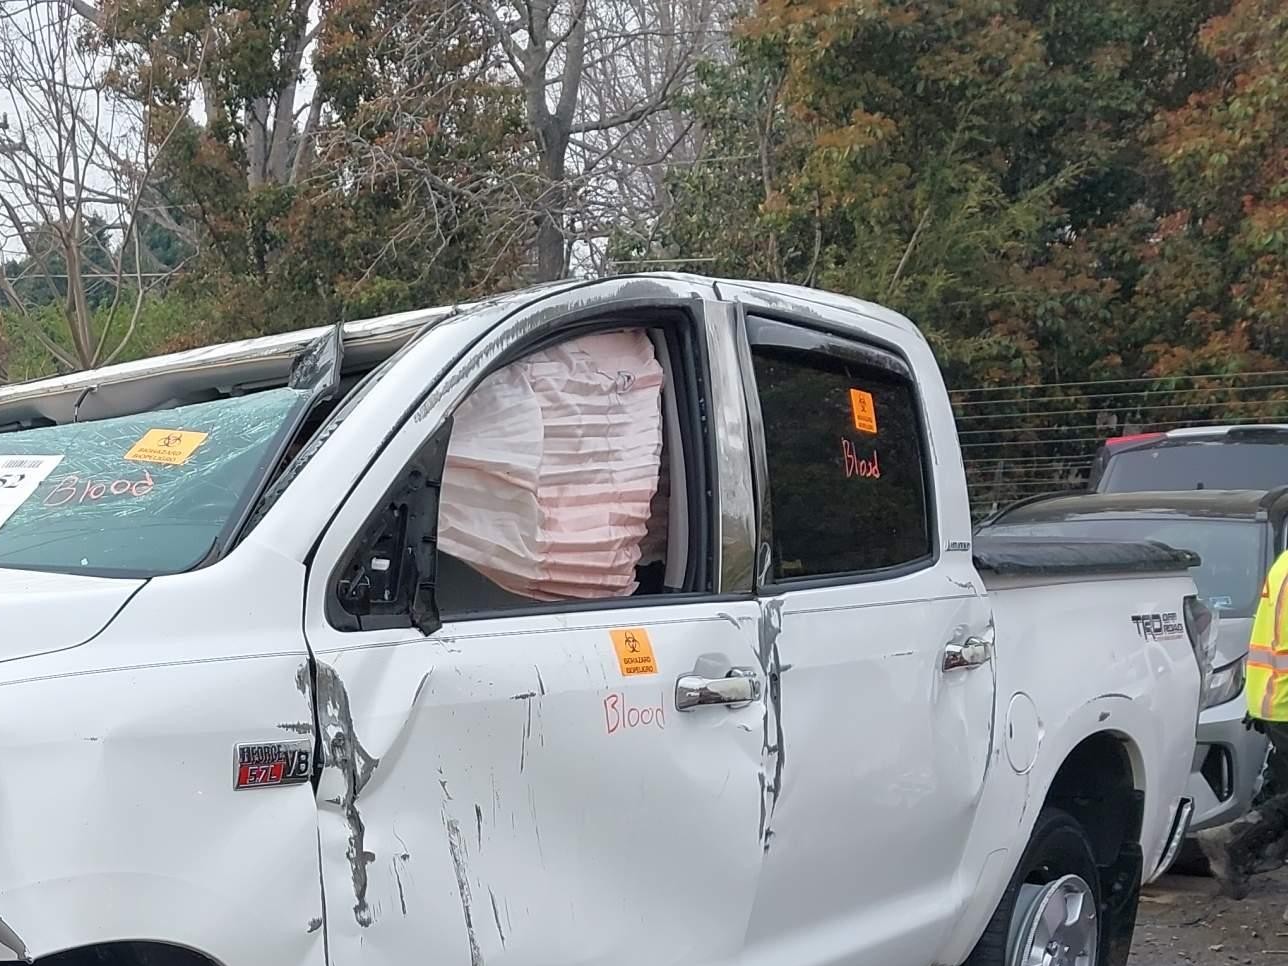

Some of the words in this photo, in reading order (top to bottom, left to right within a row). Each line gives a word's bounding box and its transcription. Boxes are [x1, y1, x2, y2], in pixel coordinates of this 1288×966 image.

[43, 469, 154, 507] Blood
[1131, 613, 1163, 641] TRD
[604, 691, 665, 734] Blood
